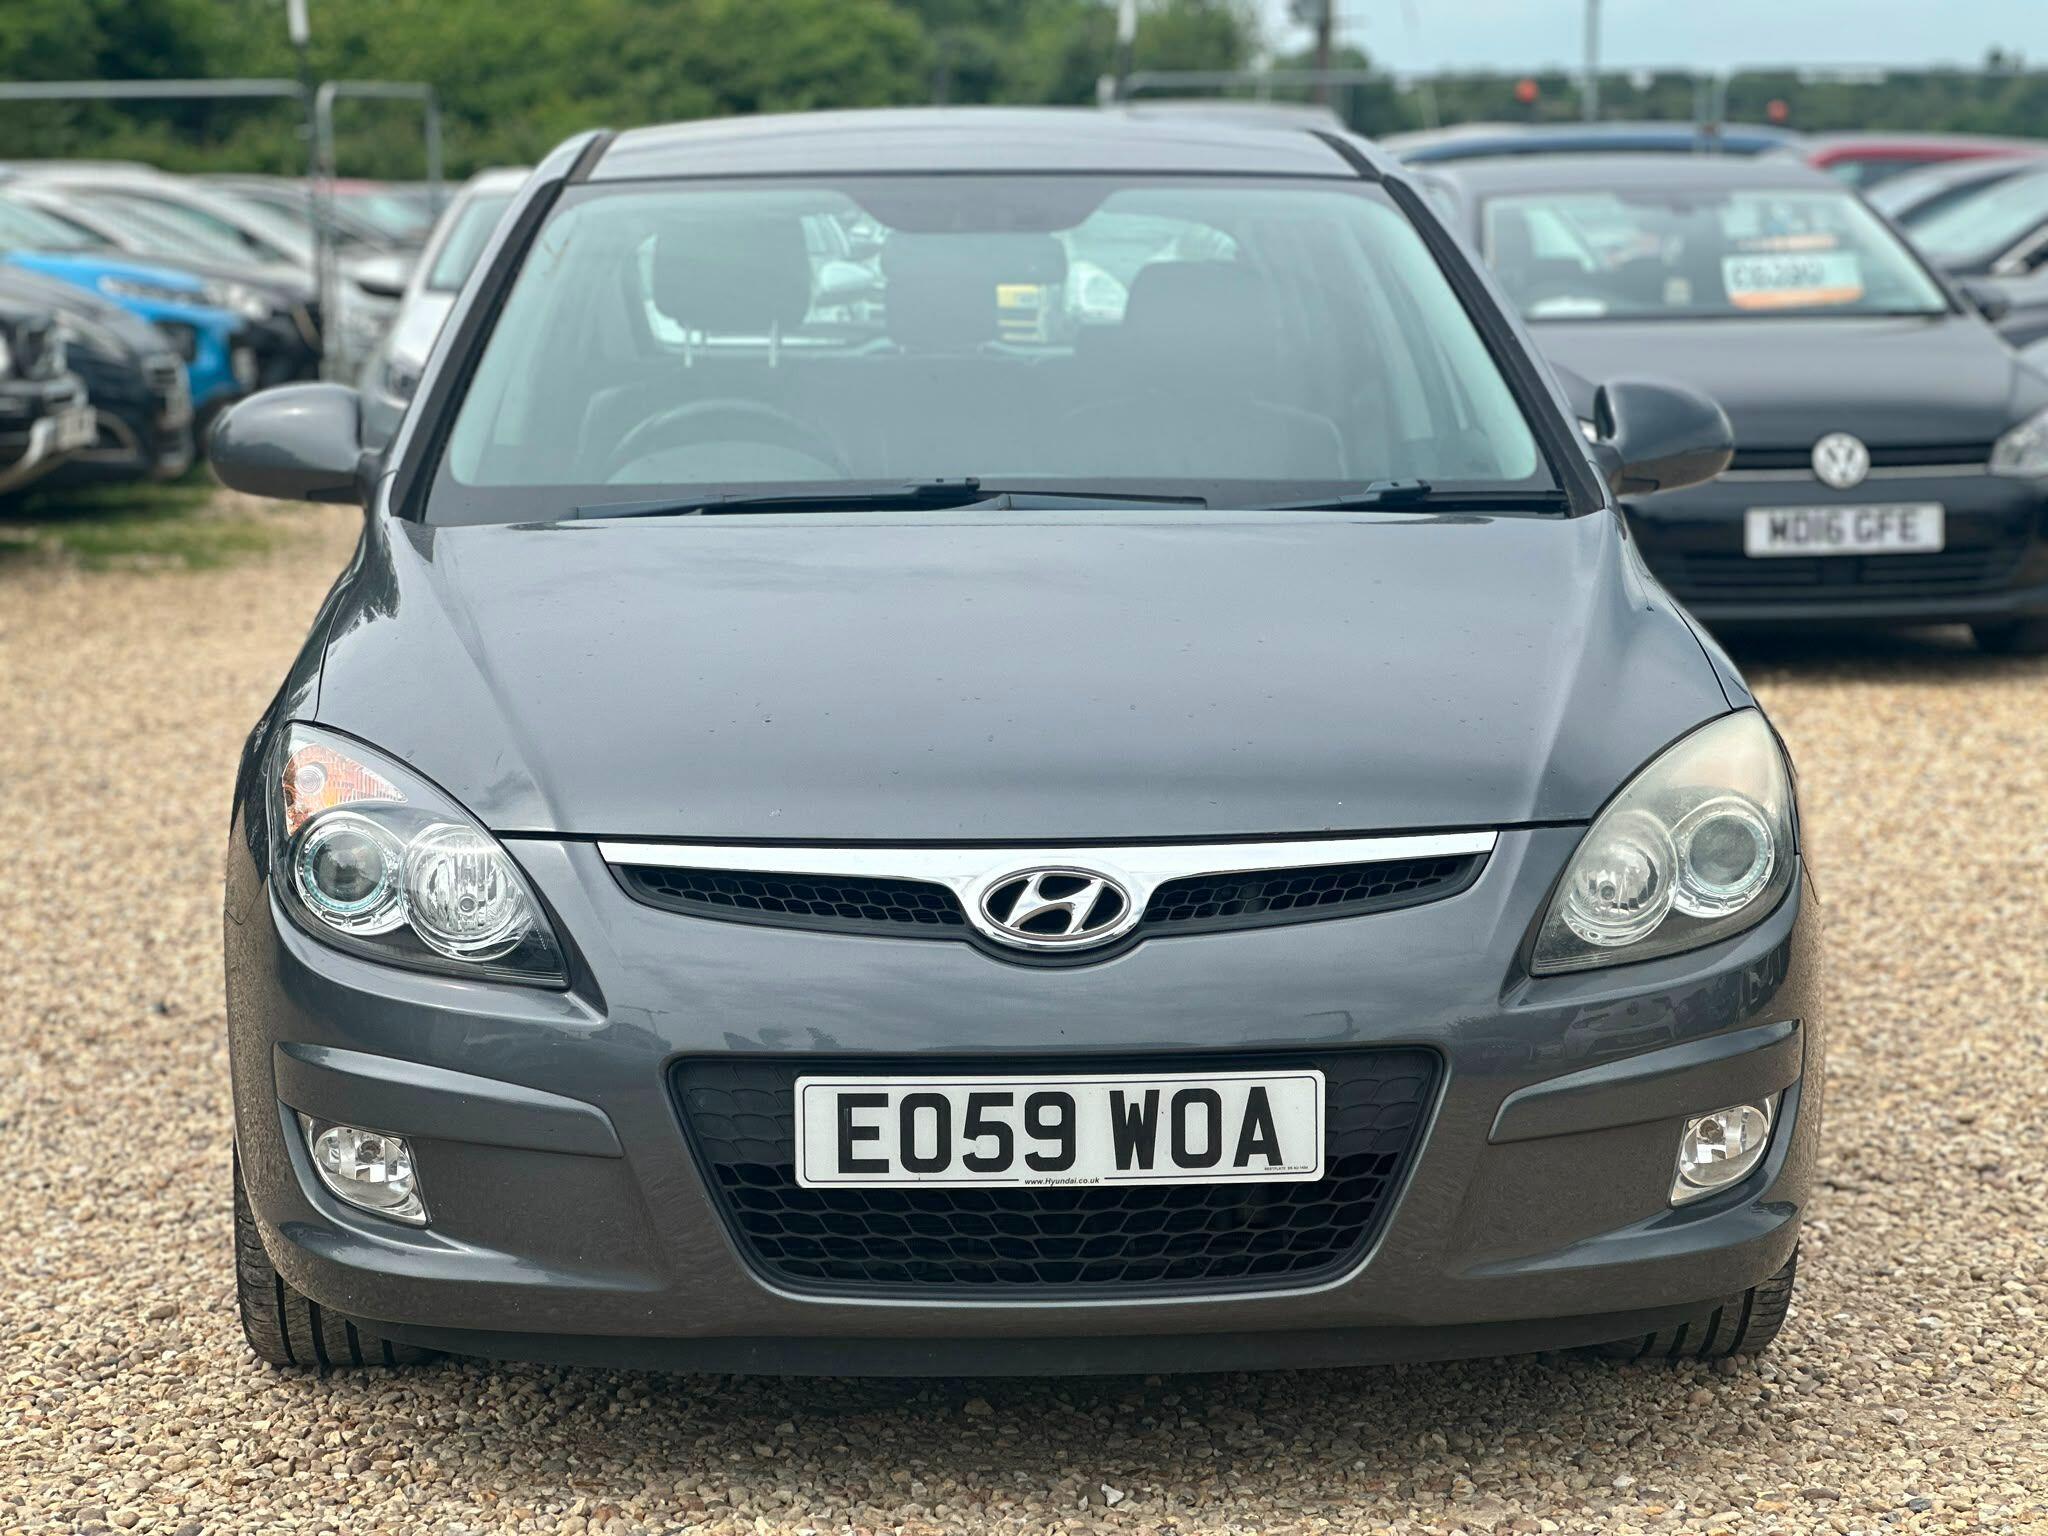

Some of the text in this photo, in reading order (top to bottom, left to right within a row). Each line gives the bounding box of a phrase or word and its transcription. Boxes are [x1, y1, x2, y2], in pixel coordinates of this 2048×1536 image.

[1854, 508, 1921, 545] GFE
[837, 1086, 1283, 1174] EO59 WOA
[1024, 1177, 1100, 1187] www.Hyundai.co.uk
